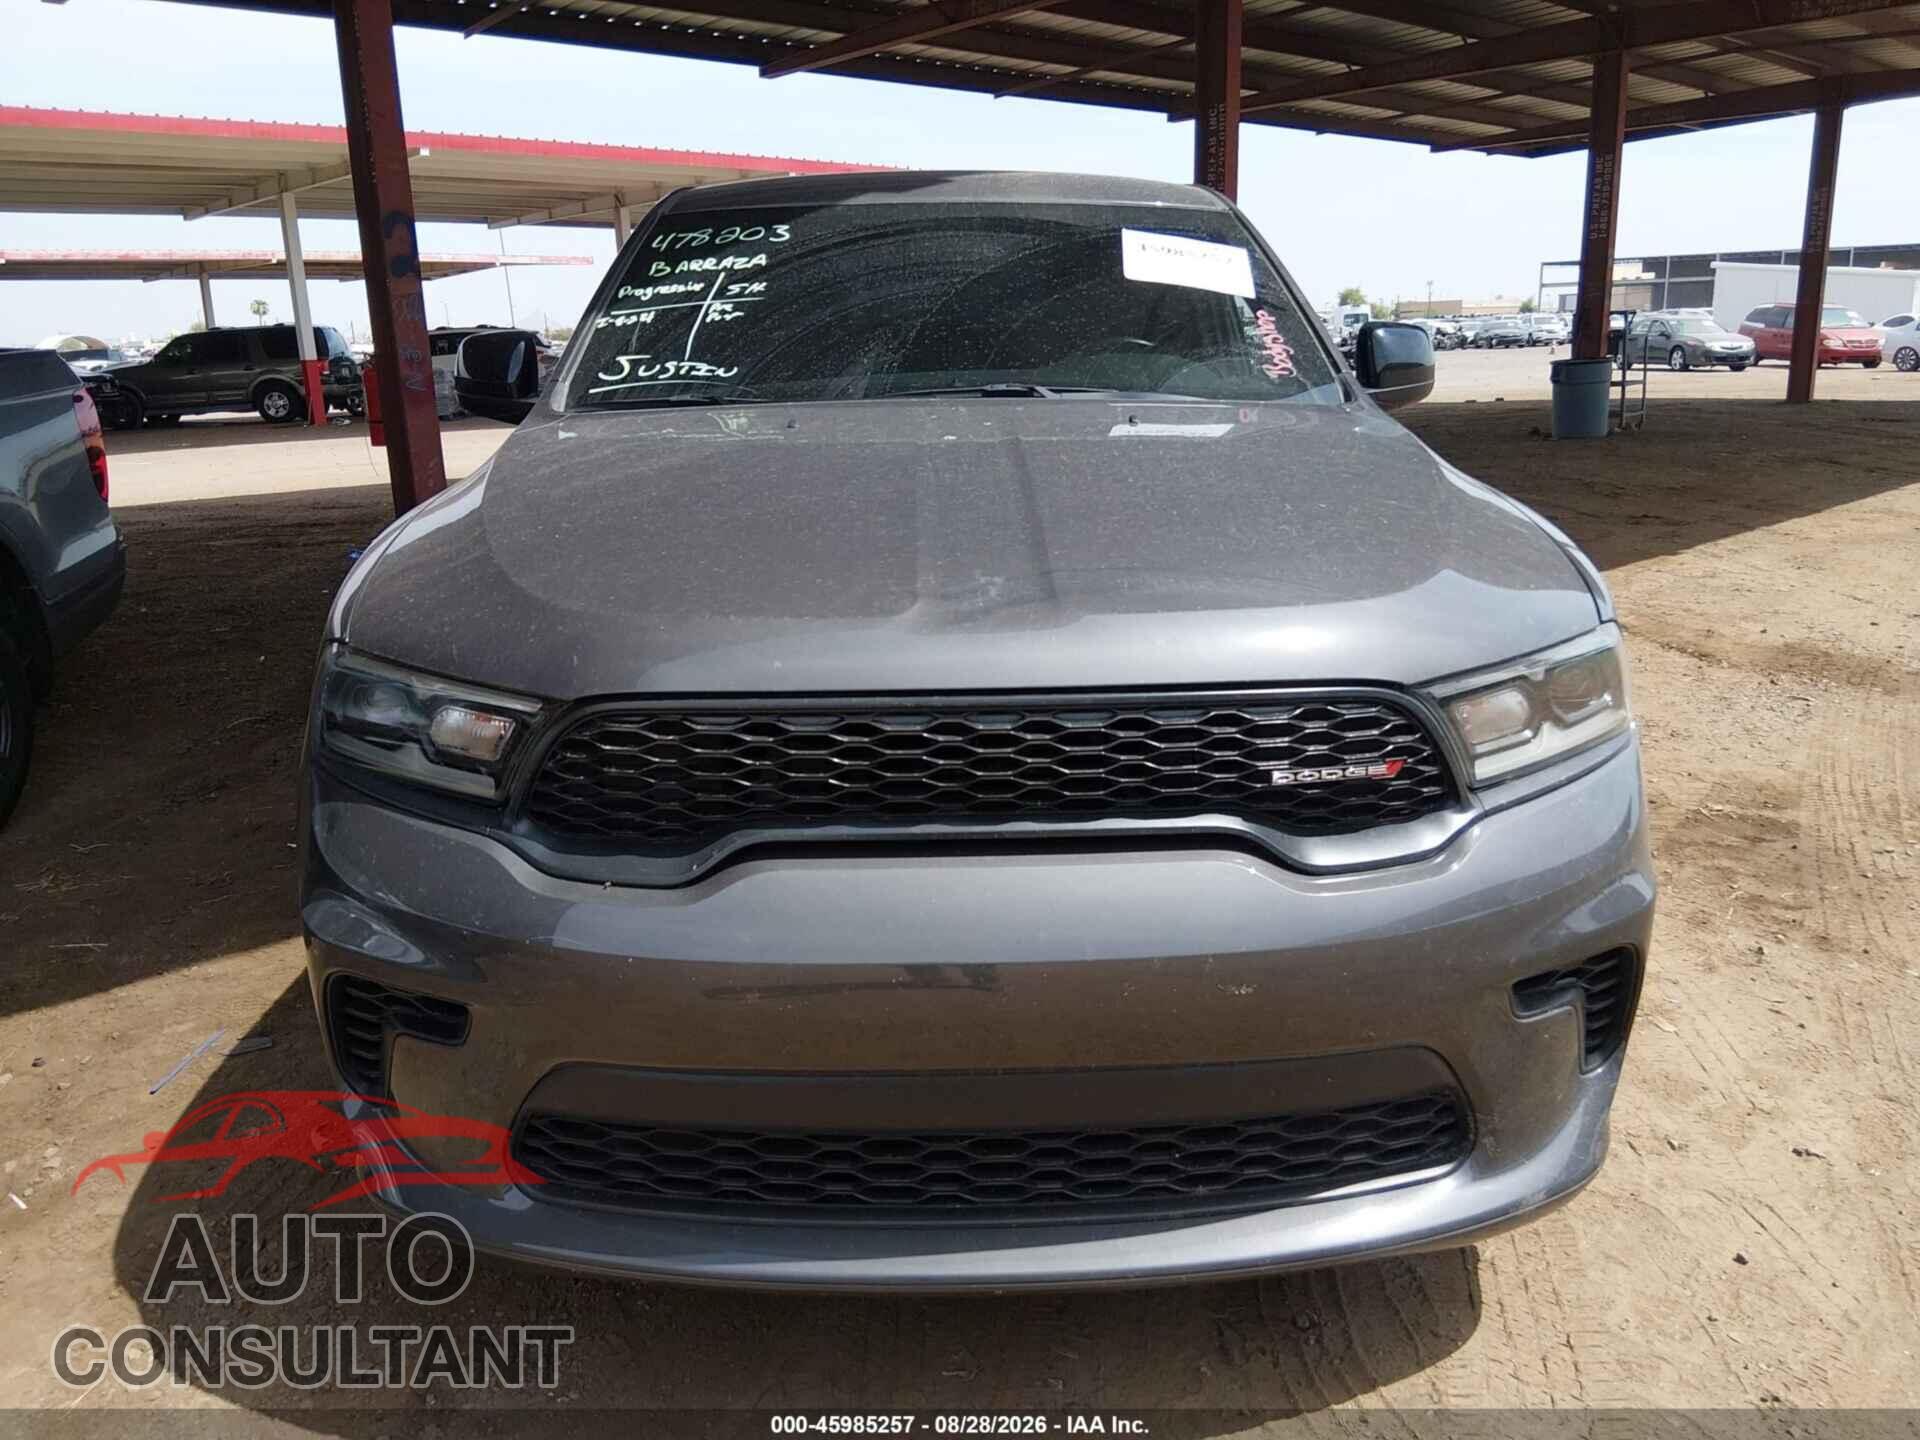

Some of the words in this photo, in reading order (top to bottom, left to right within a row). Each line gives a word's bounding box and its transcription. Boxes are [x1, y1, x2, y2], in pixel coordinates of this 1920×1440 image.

[651, 224, 791, 251] 478203
[649, 253, 767, 278] BARRAZA
[1271, 764, 1389, 785] DODGE
